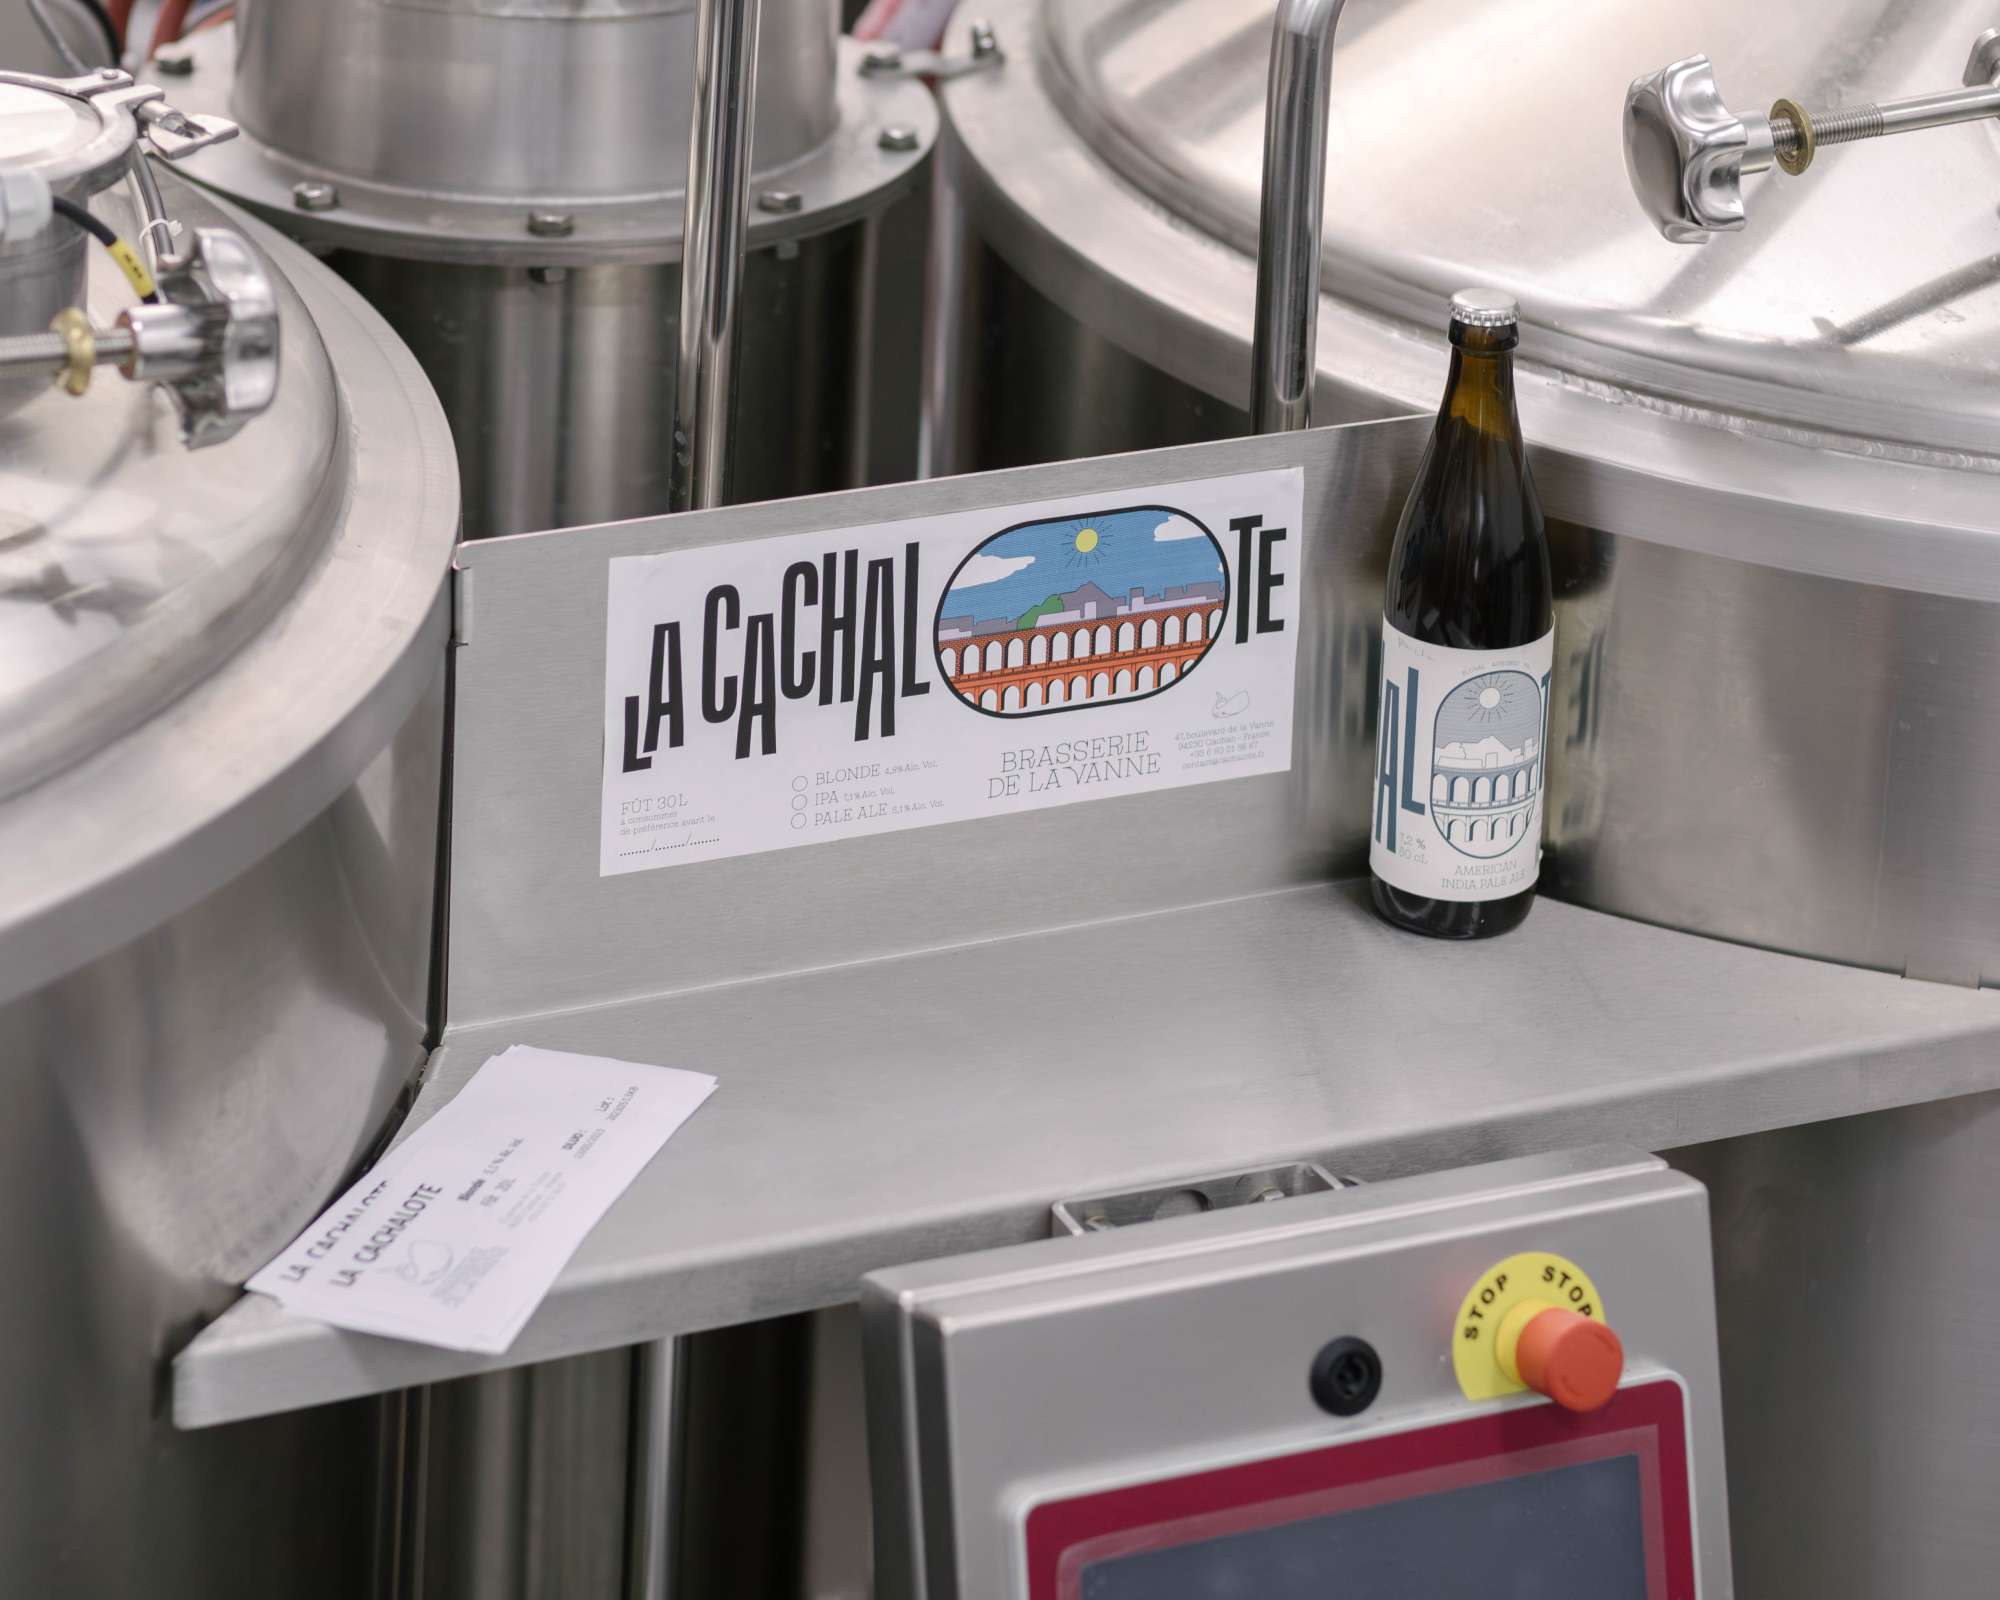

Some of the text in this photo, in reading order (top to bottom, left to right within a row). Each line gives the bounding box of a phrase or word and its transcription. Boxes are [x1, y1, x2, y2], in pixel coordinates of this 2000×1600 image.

[622, 621, 684, 773] LA
[1001, 729, 1150, 773] BRASSERIE
[815, 763, 881, 786] BLONDE
[986, 774, 1020, 799] DE
[1028, 768, 1061, 792] LA
[1063, 752, 1161, 785] VANNE
[621, 797, 653, 816] FÛT
[815, 790, 839, 807] IPA
[814, 807, 854, 827] PALE
[857, 802, 888, 821] ALE
[1441, 868, 1526, 890] INDIA PALE ALE
[1455, 859, 1518, 876] AMERICAN
[328, 1182, 444, 1287] LA CACHALOTE
[278, 1264, 312, 1283] LA
[1541, 1265, 1593, 1318] STOP
[1463, 1273, 1509, 1341] STOP
